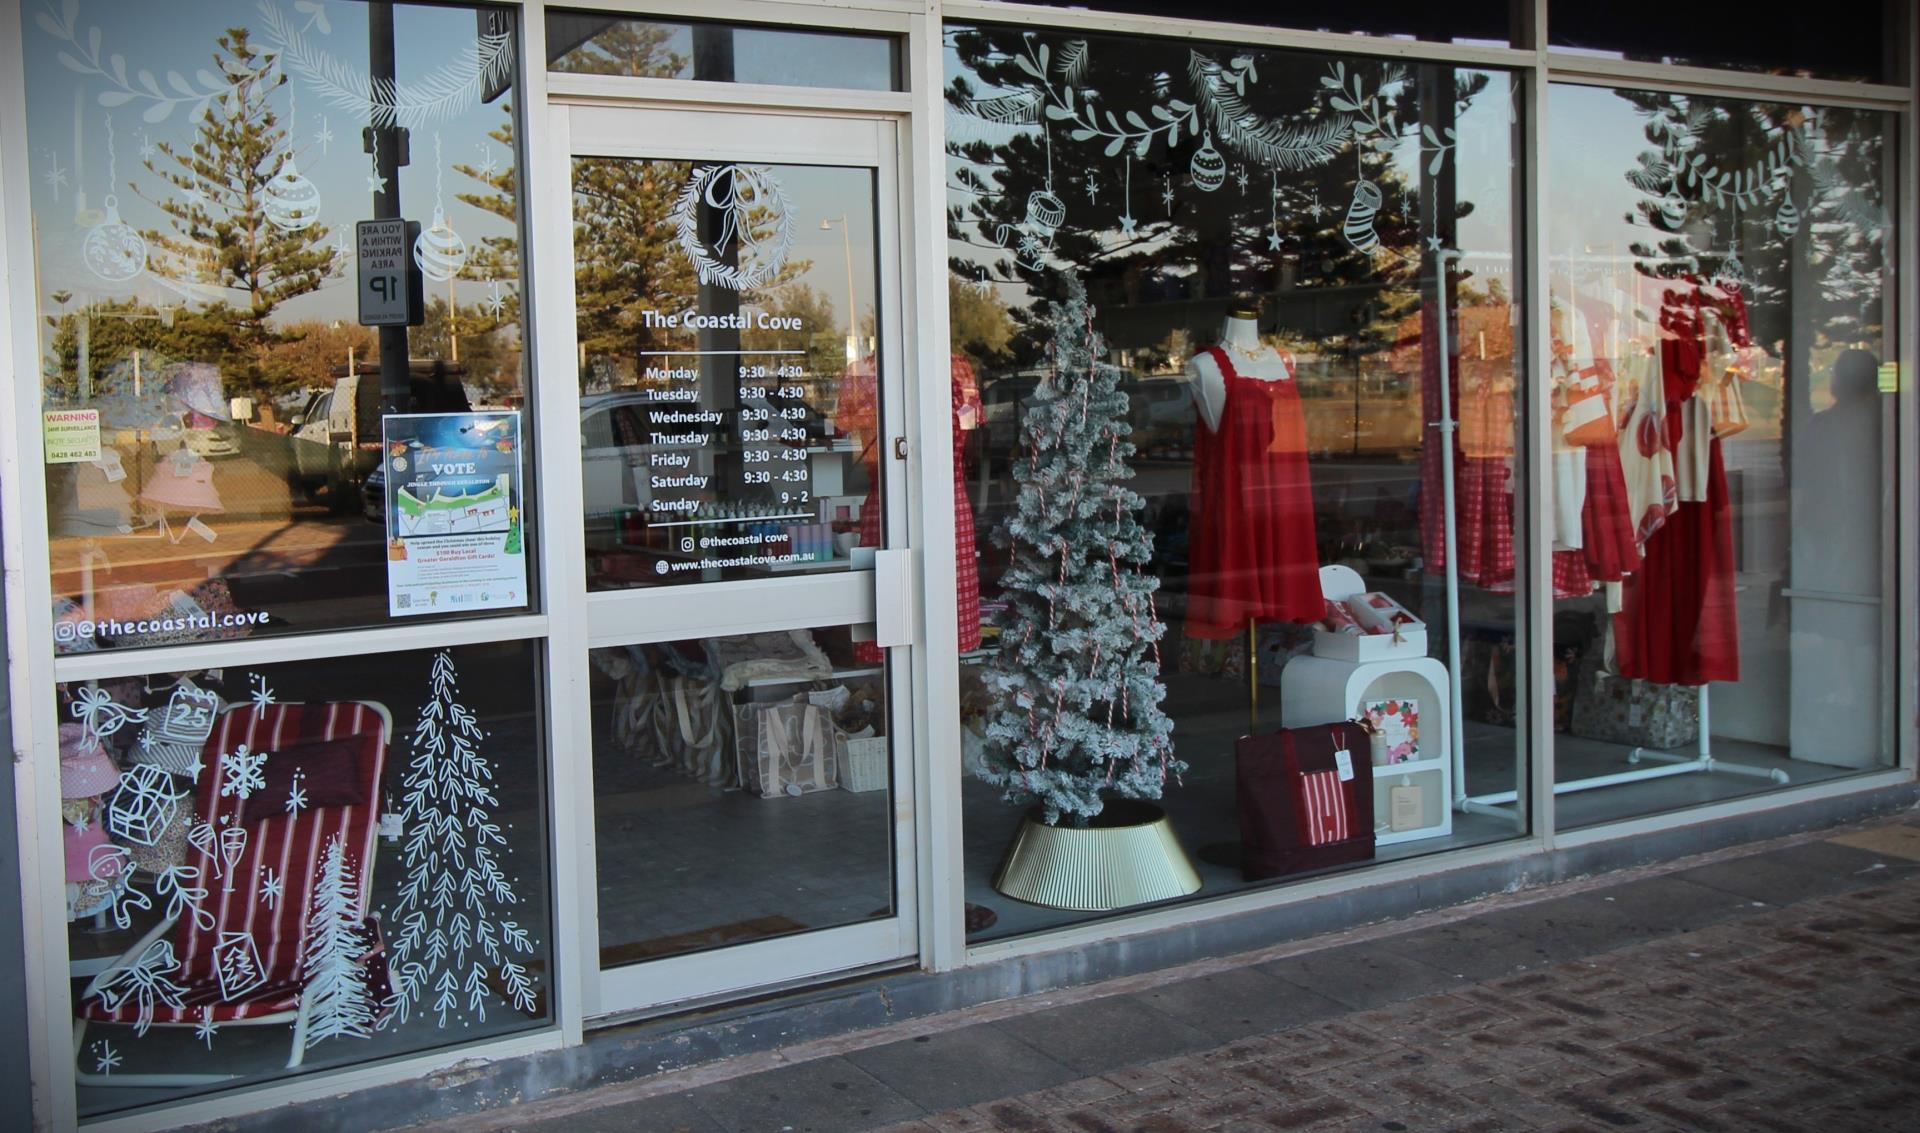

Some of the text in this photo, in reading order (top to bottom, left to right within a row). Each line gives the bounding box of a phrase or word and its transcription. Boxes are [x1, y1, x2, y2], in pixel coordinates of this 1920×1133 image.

[642, 310, 802, 330] The Coastal Cove
[646, 366, 698, 382] Monday
[739, 366, 765, 378] 9:30
[778, 366, 803, 378] 4:30
[646, 388, 698, 403] Tuesday
[739, 387, 765, 399] 9:30
[778, 387, 804, 398] 4:30
[46, 413, 96, 422] WARNING
[649, 410, 722, 424] Wednesday
[742, 409, 768, 420] 9:30
[780, 408, 806, 419] 4:30
[650, 431, 709, 446] Thursday
[743, 430, 769, 441] 9:30
[781, 428, 806, 440] 4:30
[651, 454, 690, 468] Friday
[743, 450, 769, 462] 9:30
[781, 449, 807, 461] 4:30
[432, 462, 476, 475] VOTE
[651, 474, 708, 488] Saturday
[744, 472, 770, 484] 9:30
[782, 470, 808, 482] 4:30
[652, 498, 699, 512] Sunday
[782, 492, 789, 503] 9
[801, 491, 808, 502] 2
[700, 533, 788, 548] @thecoastal cove
[671, 552, 815, 571] www.thecoastalcove.com.au
[77, 611, 270, 638] @thecoastal.cove
[176, 703, 209, 727] 25
